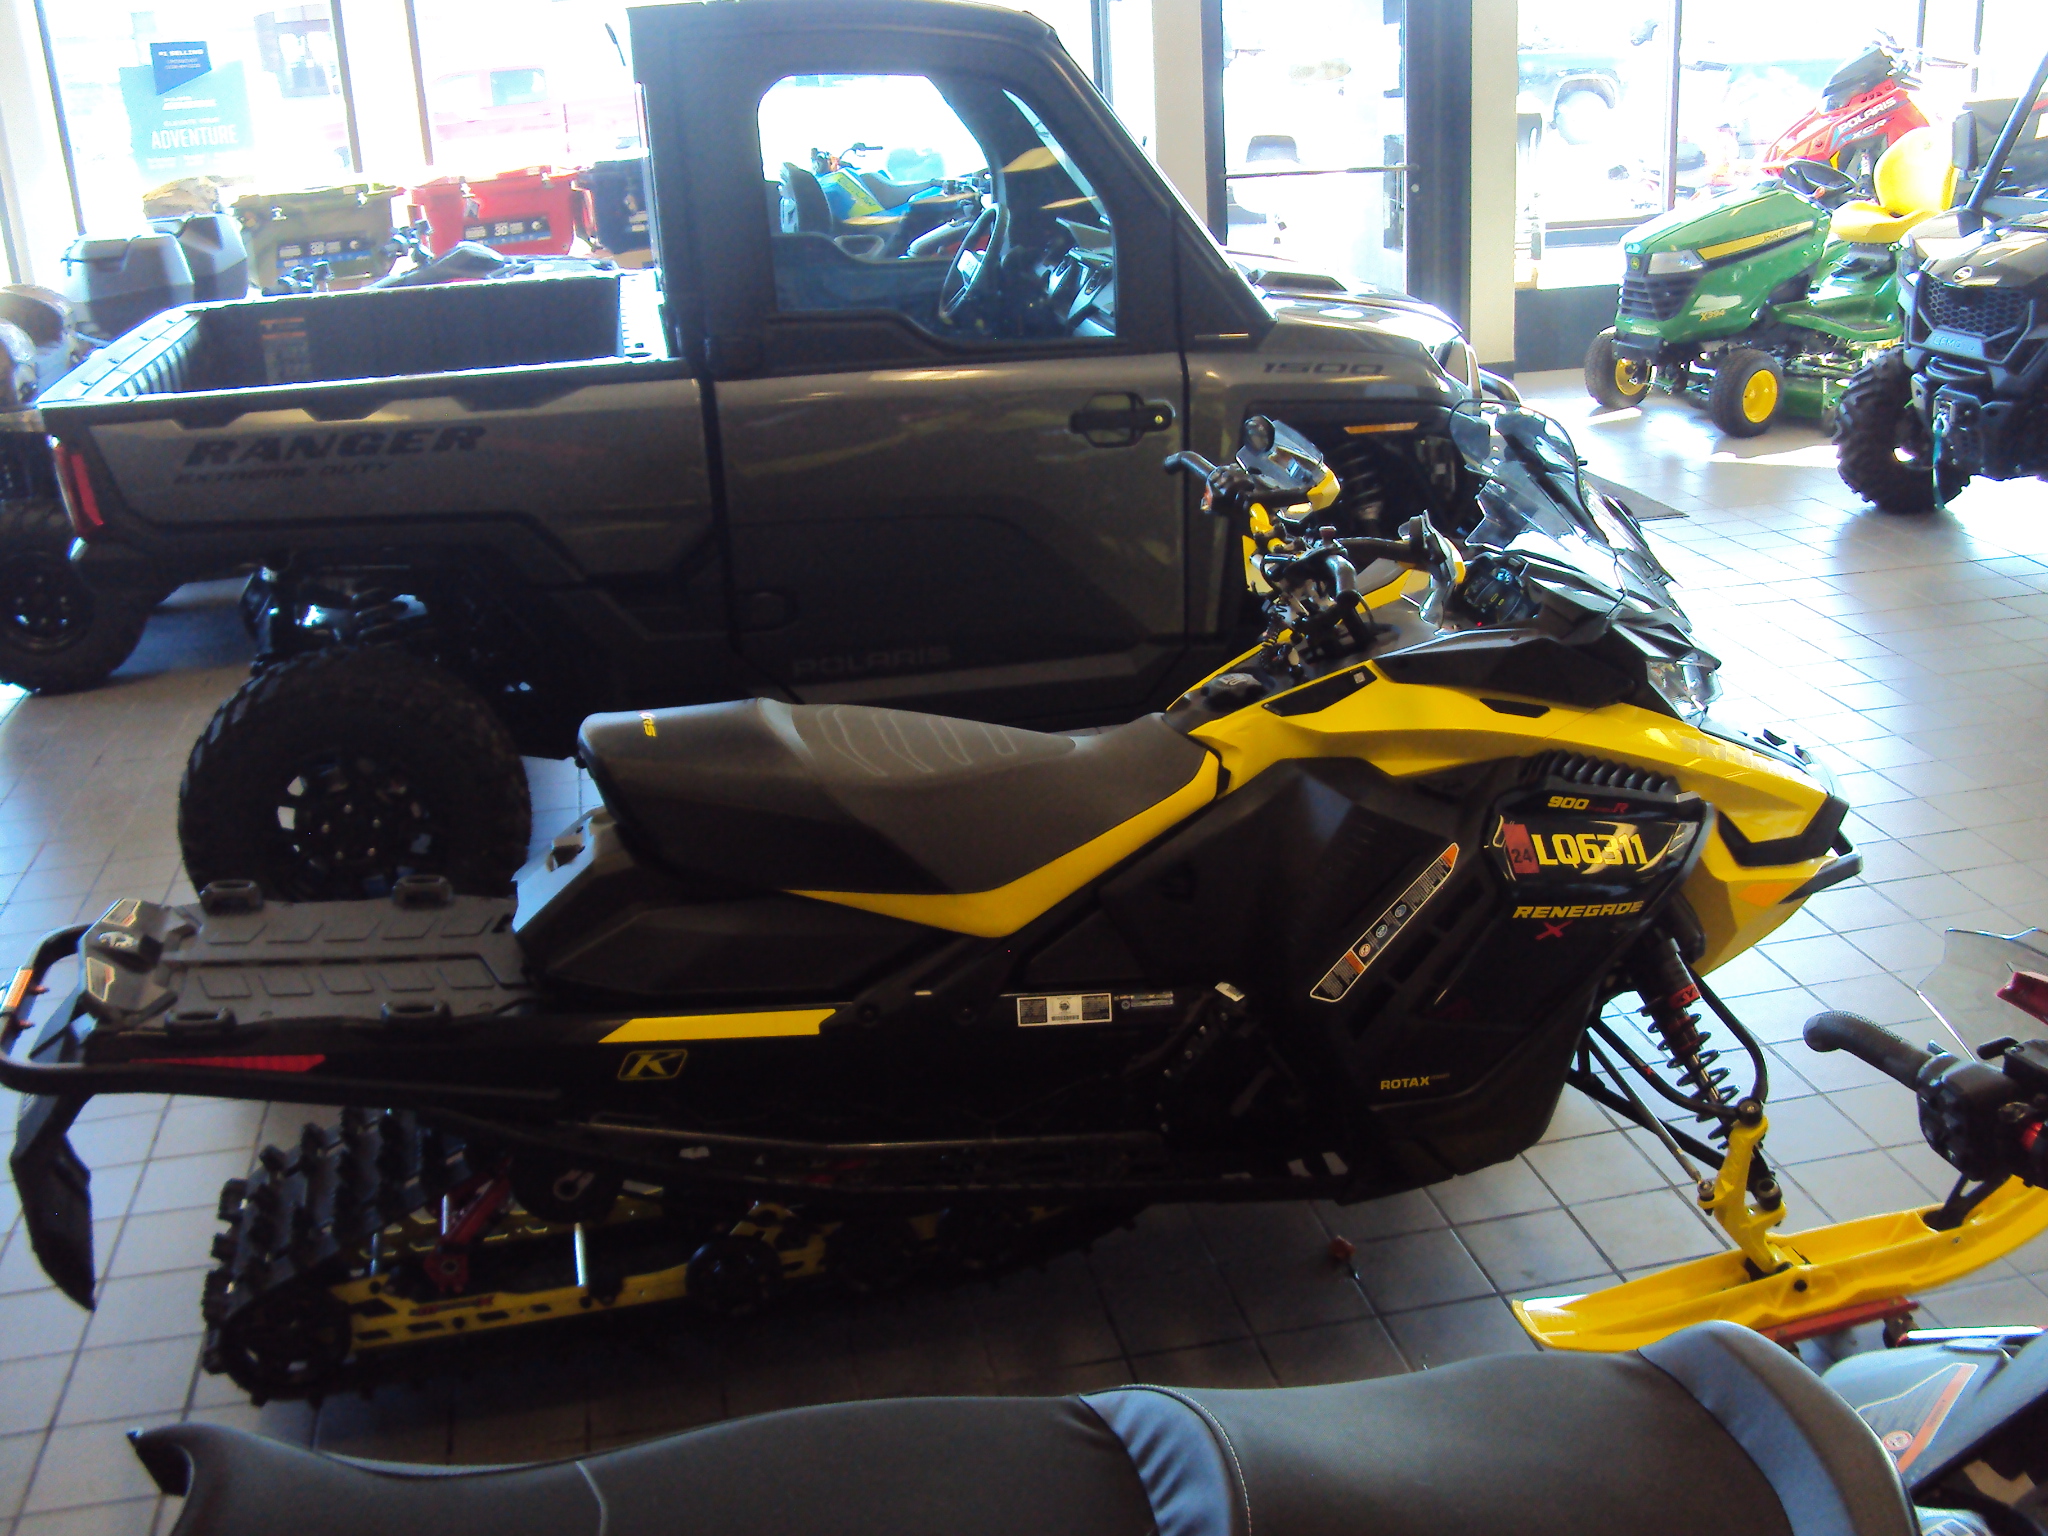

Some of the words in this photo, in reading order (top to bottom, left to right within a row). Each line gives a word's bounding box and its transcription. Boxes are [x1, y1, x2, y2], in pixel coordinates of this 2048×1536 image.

[1837, 96, 1897, 133] POLARIS
[151, 124, 238, 150] ADVENTURE
[1264, 363, 1384, 375] 1500
[185, 426, 486, 466] RANGER
[792, 646, 952, 679] POLARIS
[1547, 796, 1590, 810] 900
[1511, 848, 1532, 863] 24
[1531, 833, 1648, 868] LQ6311
[1512, 901, 1645, 919] RENEGADE
[1380, 1076, 1430, 1090] ROTAX
